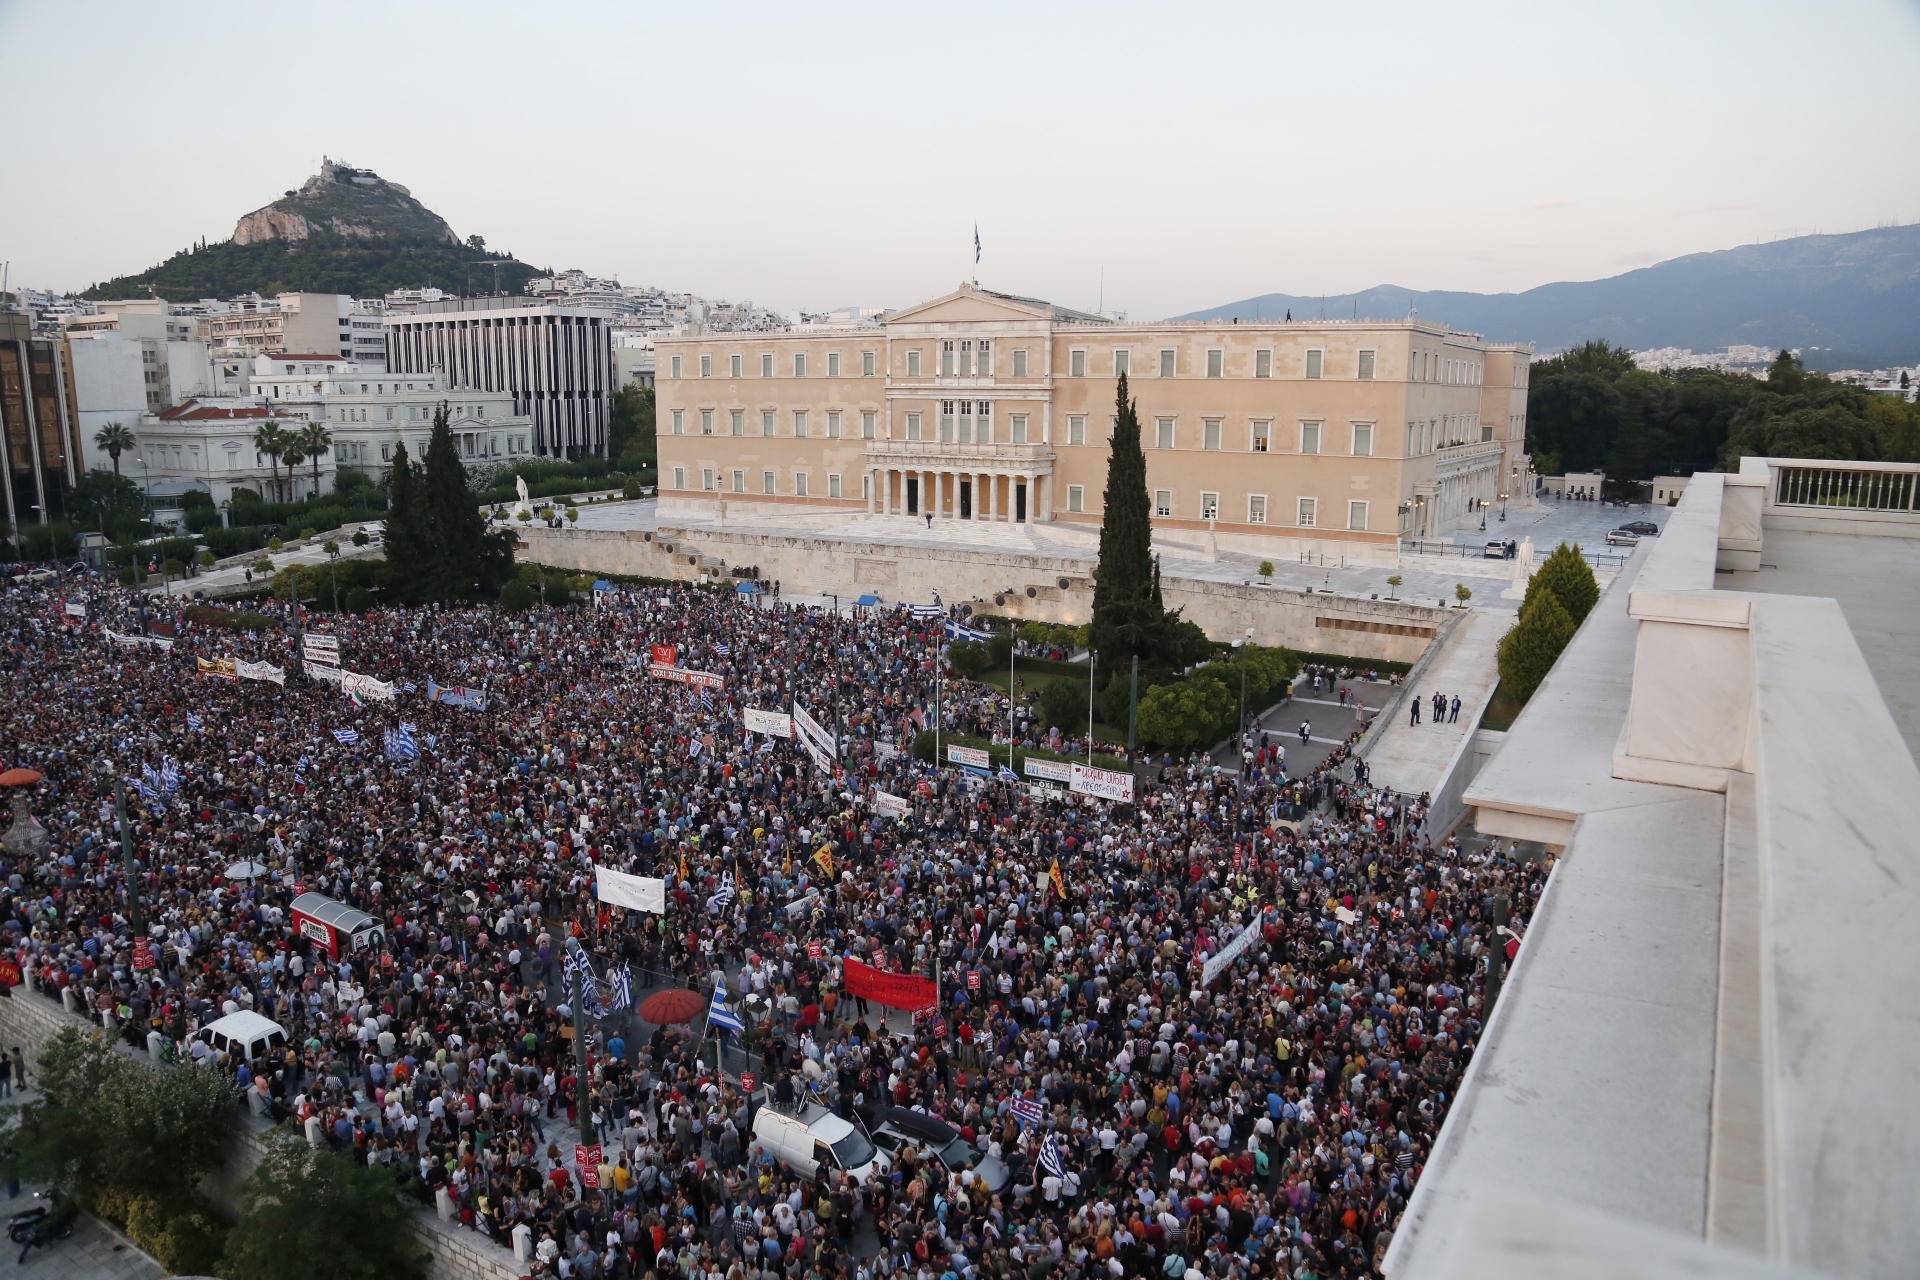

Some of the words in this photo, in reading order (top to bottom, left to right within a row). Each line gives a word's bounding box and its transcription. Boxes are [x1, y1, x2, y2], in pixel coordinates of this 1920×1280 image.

[653, 669, 665, 677] ΟΧΙ
[690, 675, 706, 684] NOT
[709, 679, 723, 687] DEBT
[1026, 764, 1039, 775] ΟΧΙ
[1039, 781, 1053, 790] ΟΧΙ
